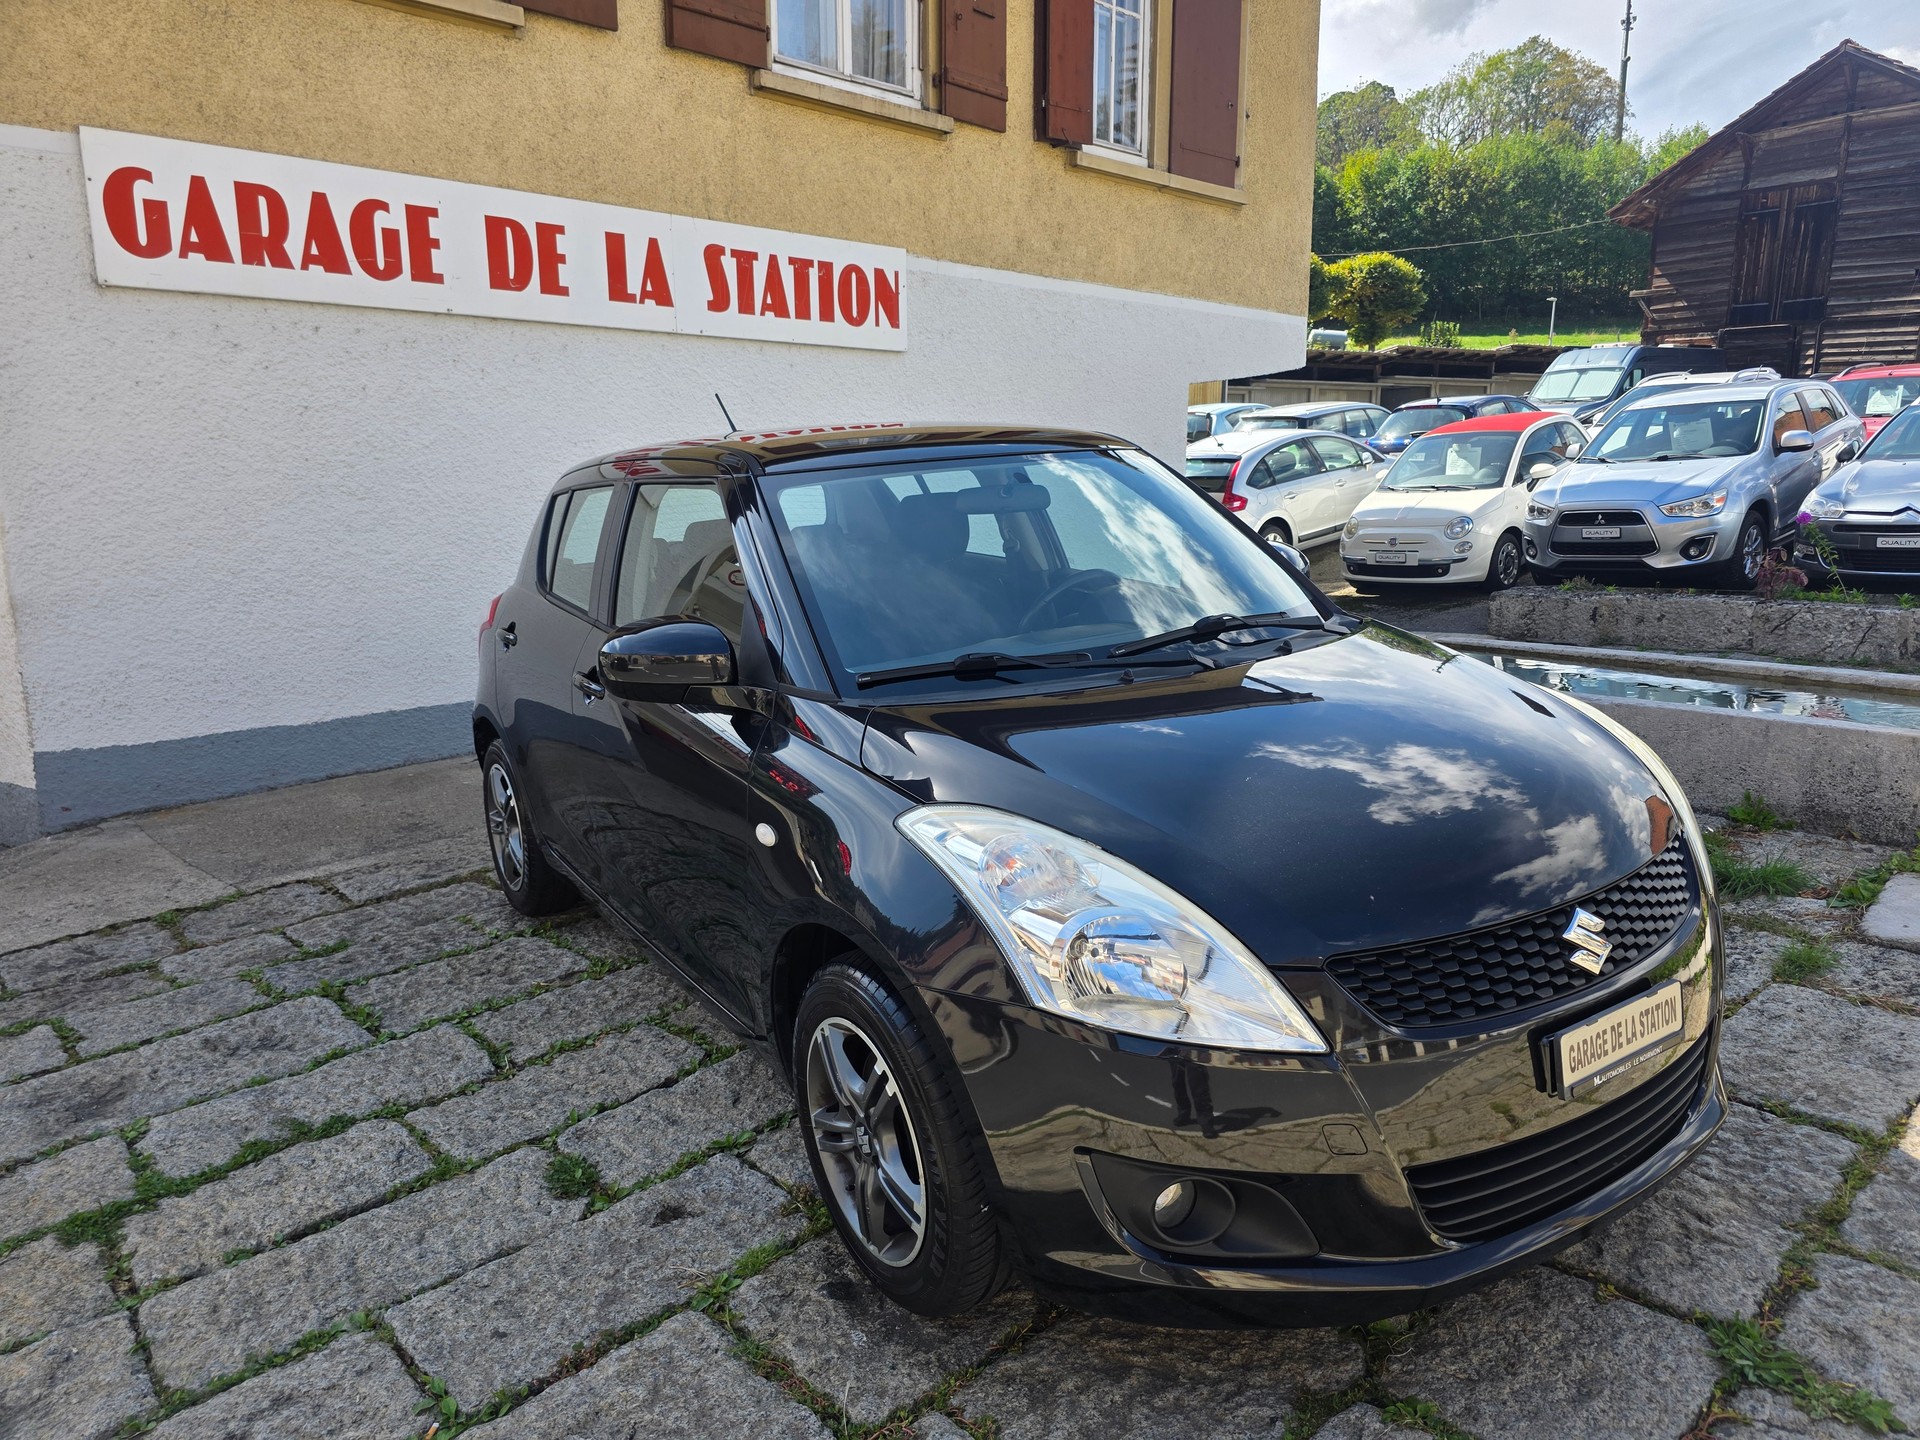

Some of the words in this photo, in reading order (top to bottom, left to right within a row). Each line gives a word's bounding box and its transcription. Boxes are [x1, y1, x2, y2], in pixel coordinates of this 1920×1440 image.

[103, 167, 443, 284] GARAGE
[485, 215, 568, 296] DE
[605, 232, 673, 307] LA
[703, 244, 899, 328] STATION
[1568, 1028, 1609, 1074] GARAGE
[1610, 1021, 1624, 1053] DE
[1625, 1015, 1638, 1046] LA
[1638, 995, 1677, 1039] STATION
